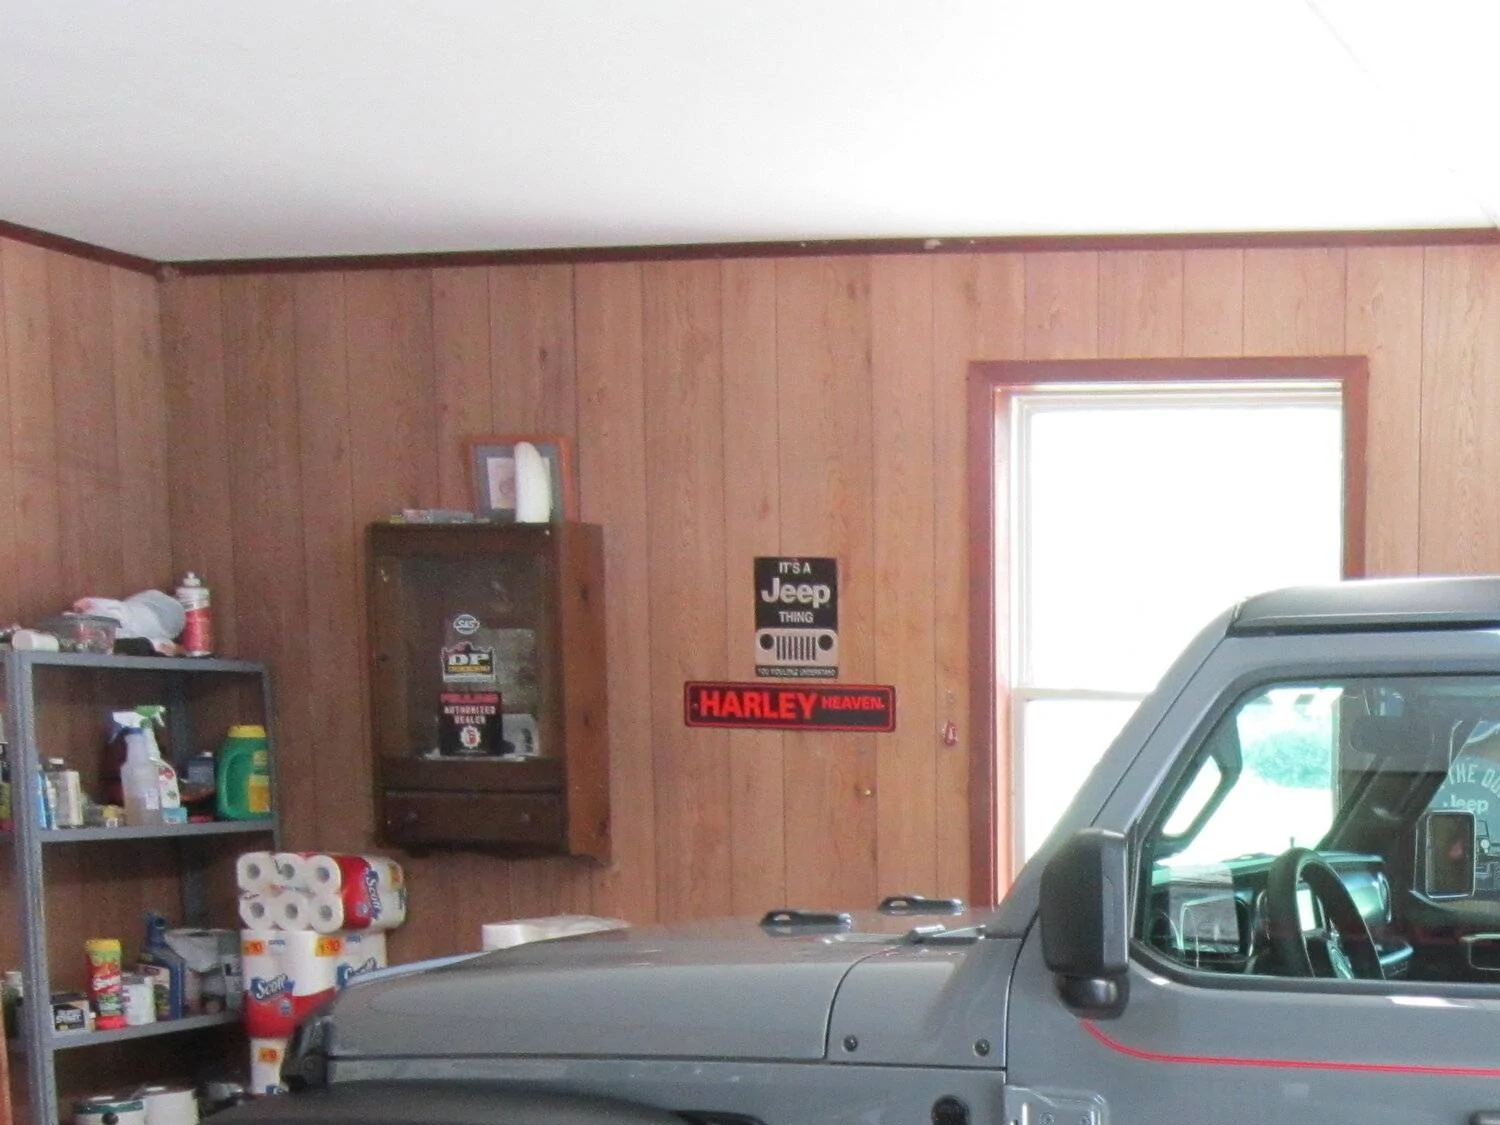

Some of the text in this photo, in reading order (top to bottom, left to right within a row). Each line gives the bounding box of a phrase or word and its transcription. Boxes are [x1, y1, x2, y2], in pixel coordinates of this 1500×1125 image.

[779, 562, 811, 574] IT'S A
[761, 577, 831, 608] Jeep
[778, 610, 814, 623] THING
[700, 690, 817, 719] HARLEY
[1442, 792, 1489, 815] Jeep
